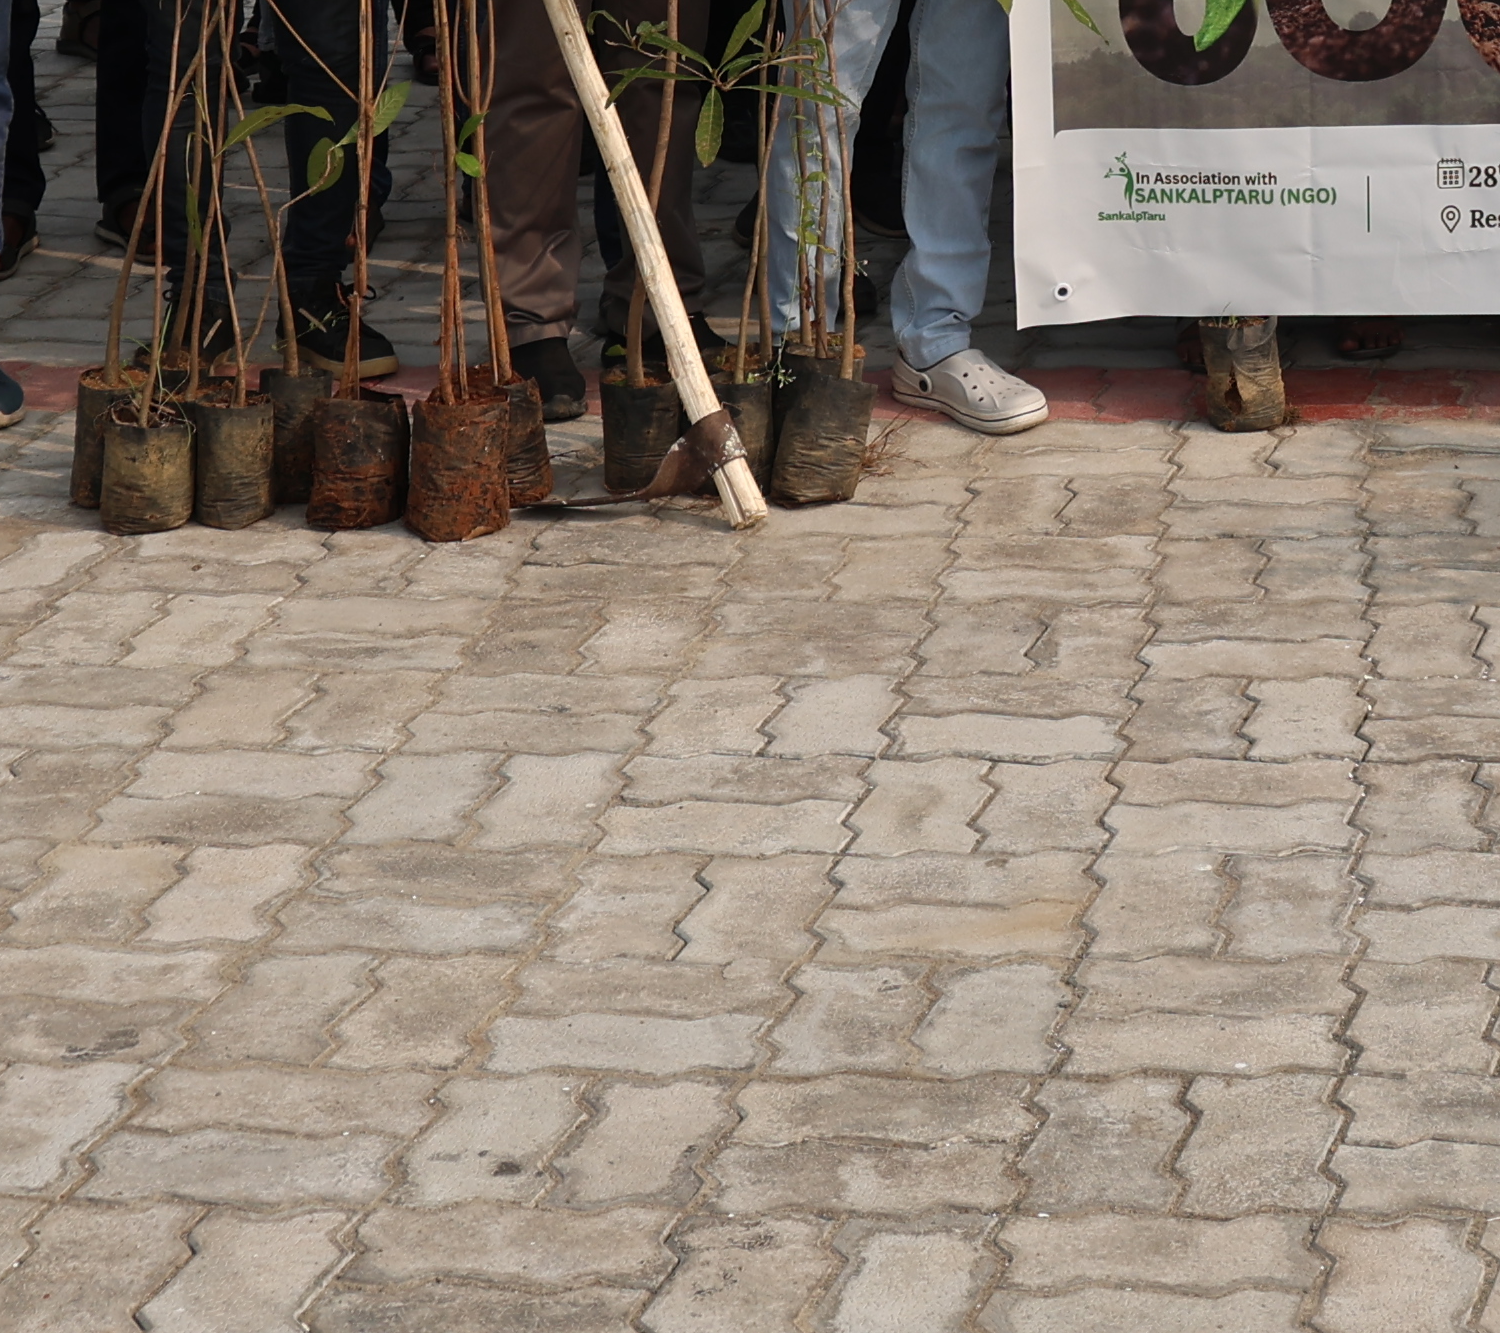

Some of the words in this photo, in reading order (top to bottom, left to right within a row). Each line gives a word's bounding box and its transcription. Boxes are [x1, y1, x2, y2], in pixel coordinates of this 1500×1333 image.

[1136, 172, 1150, 184] In
[1154, 172, 1241, 186] Association
[1244, 172, 1277, 186] with
[1134, 188, 1274, 205] SANKALPTARU
[1280, 187, 1337, 206] (NGO)
[1098, 211, 1166, 223] SankalpTaru
